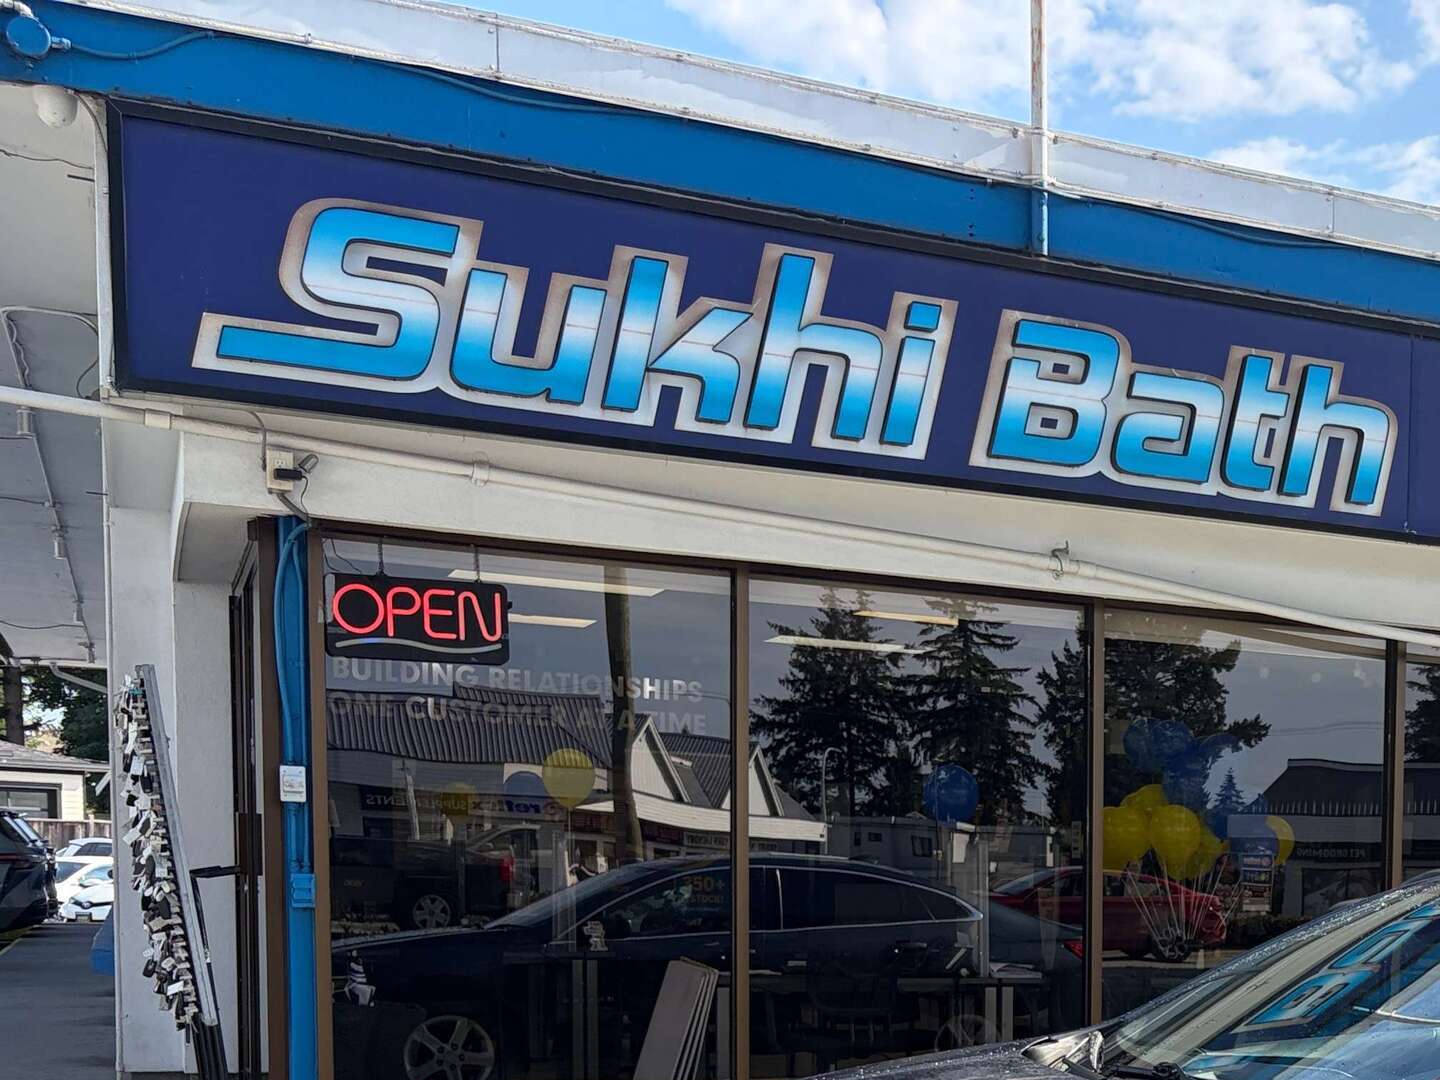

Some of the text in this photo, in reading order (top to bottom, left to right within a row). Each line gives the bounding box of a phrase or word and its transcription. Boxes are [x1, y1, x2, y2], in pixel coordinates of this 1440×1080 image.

[192, 198, 959, 460] Sukhi
[969, 308, 1398, 516] Bath
[331, 582, 505, 643] OPEN
[331, 657, 703, 704] BUILDING RELATIONSHIPS
[329, 692, 393, 719] ONE
[405, 696, 563, 728] CUSTOMER
[617, 709, 636, 731] A
[643, 711, 708, 736] TIME
